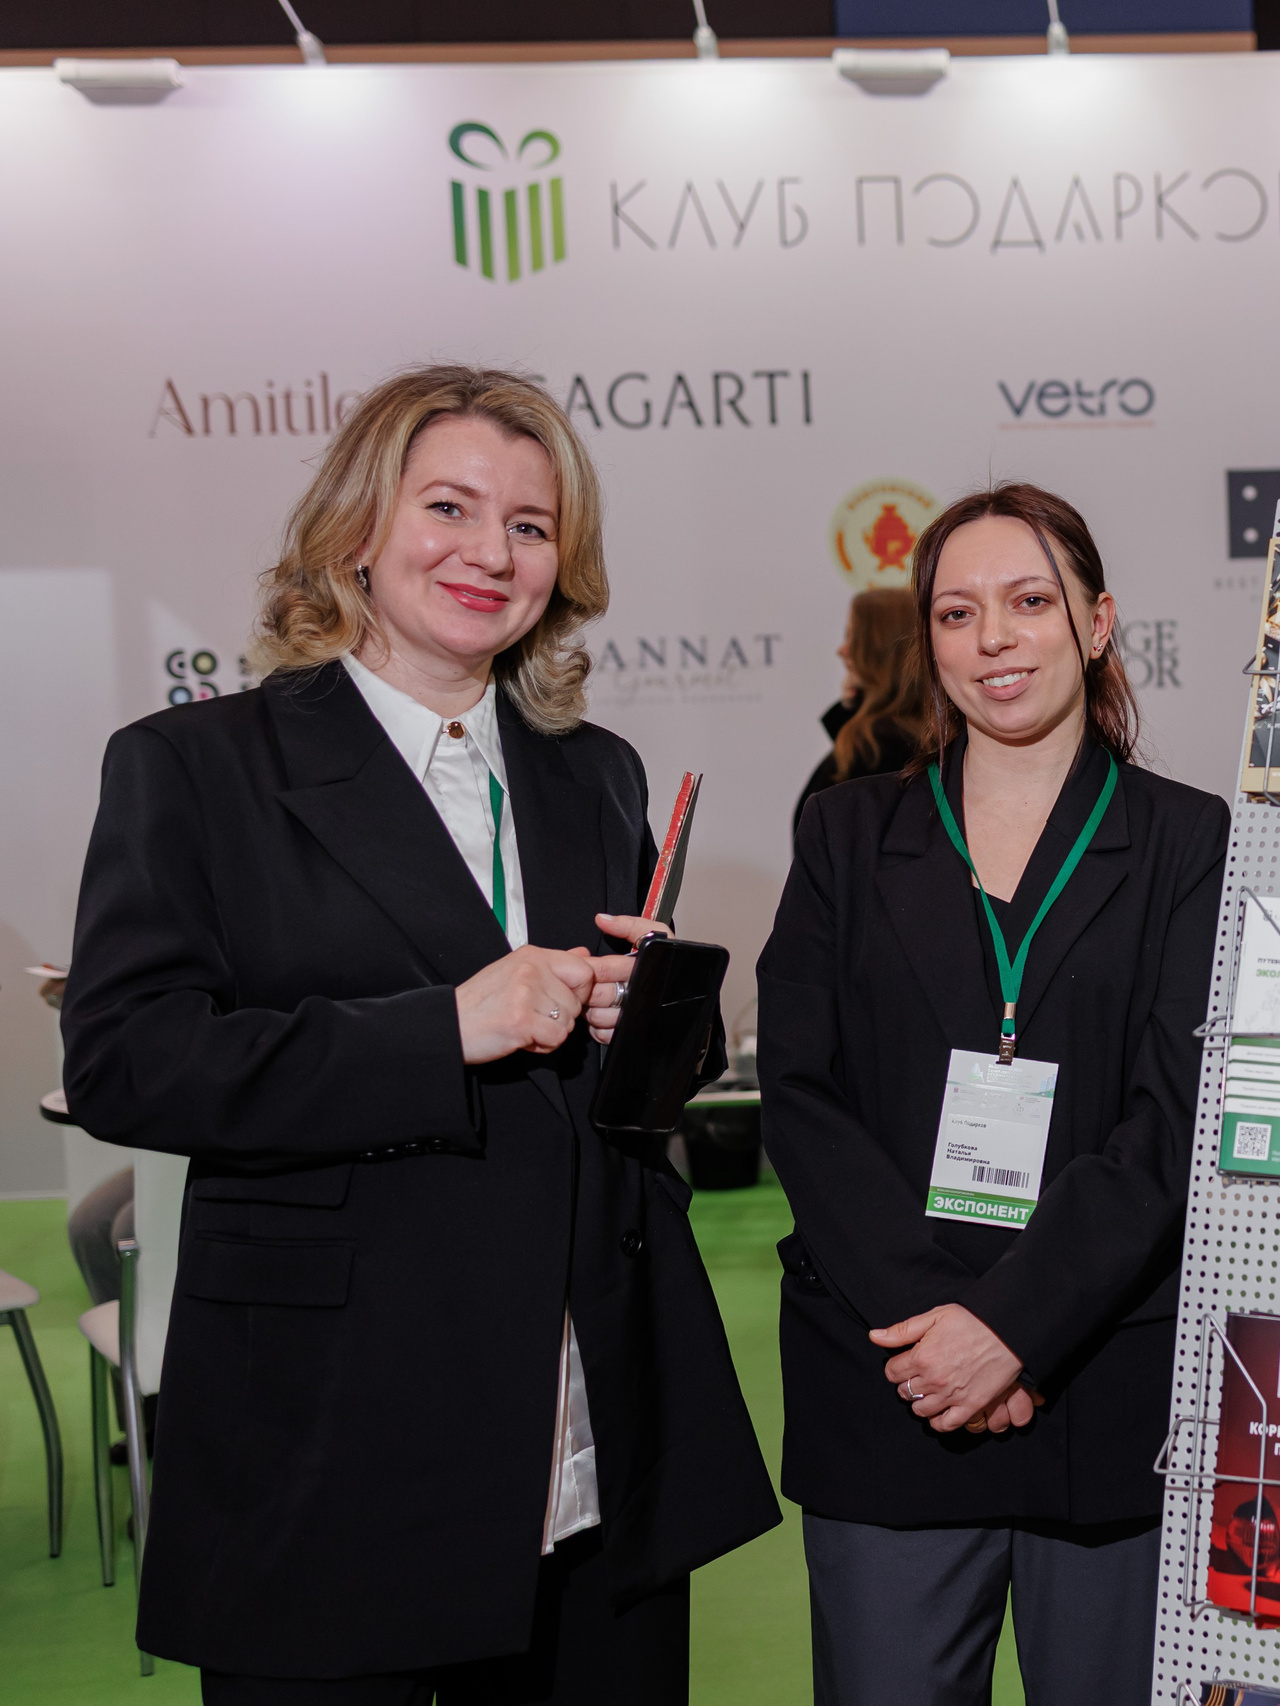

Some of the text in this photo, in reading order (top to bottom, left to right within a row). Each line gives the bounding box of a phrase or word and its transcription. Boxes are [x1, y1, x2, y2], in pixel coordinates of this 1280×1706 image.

[608, 177, 811, 252] КЛУБ
[522, 369, 814, 430] AGARTI
[997, 378, 1156, 419] vetro
[598, 632, 783, 672] ANNAT
[946, 1148, 972, 1156] Наталья
[948, 1141, 978, 1152] Голубкова
[933, 1195, 1030, 1221] ЭКСПОНЕНТ
